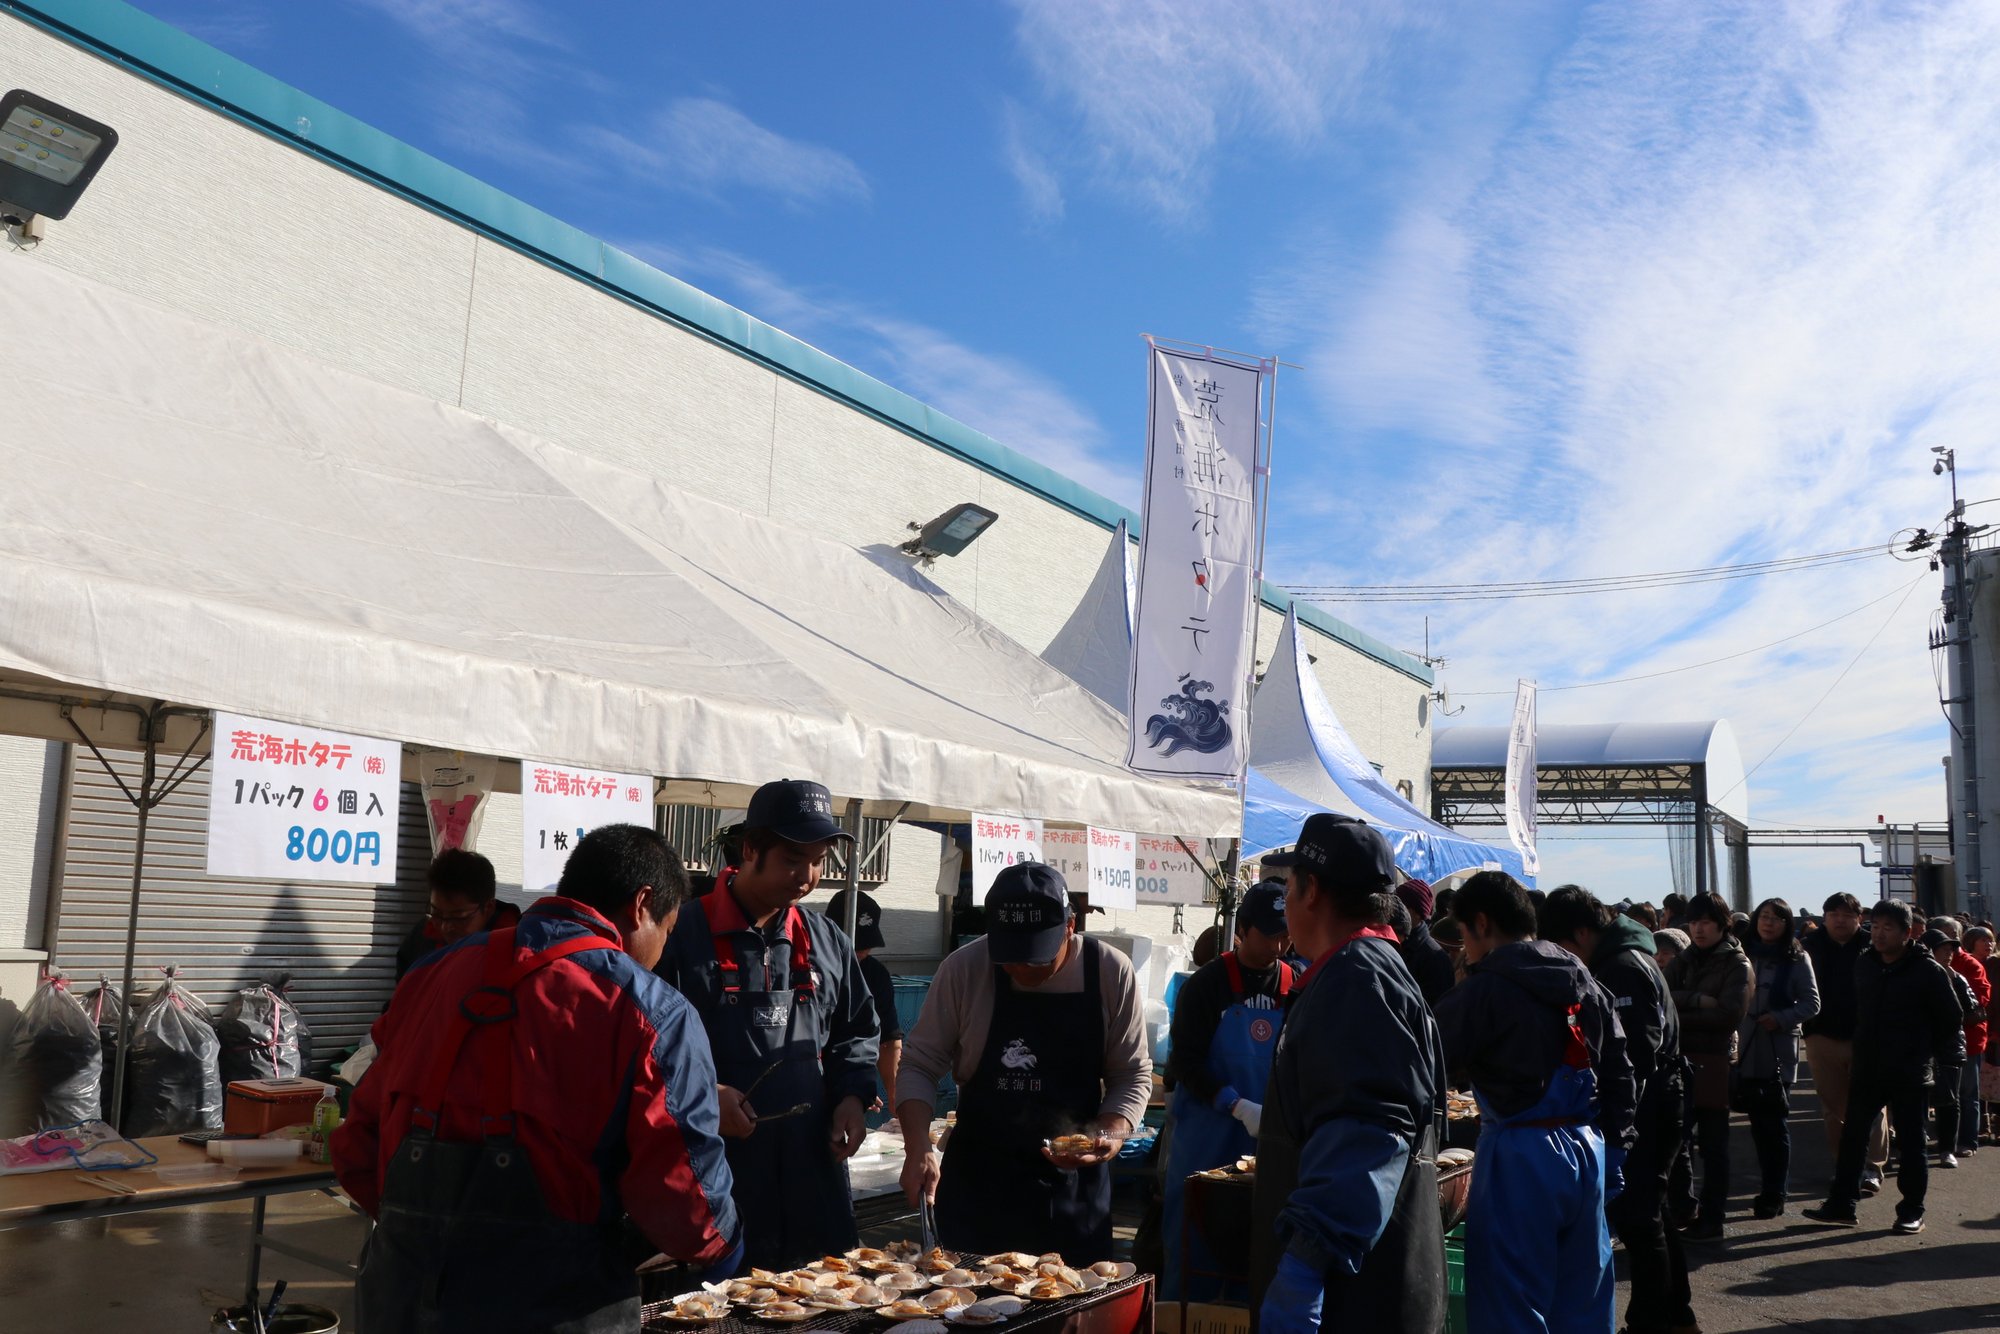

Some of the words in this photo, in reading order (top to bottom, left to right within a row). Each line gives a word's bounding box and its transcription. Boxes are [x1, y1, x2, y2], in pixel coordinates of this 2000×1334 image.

[230, 730, 353, 770] 荒海ホタテ
[534, 768, 618, 800] 荒海ホタテ
[977, 819, 1021, 840] 荒海ホタテ
[285, 825, 381, 867] 800円
[1104, 866, 1131, 890] 150円
